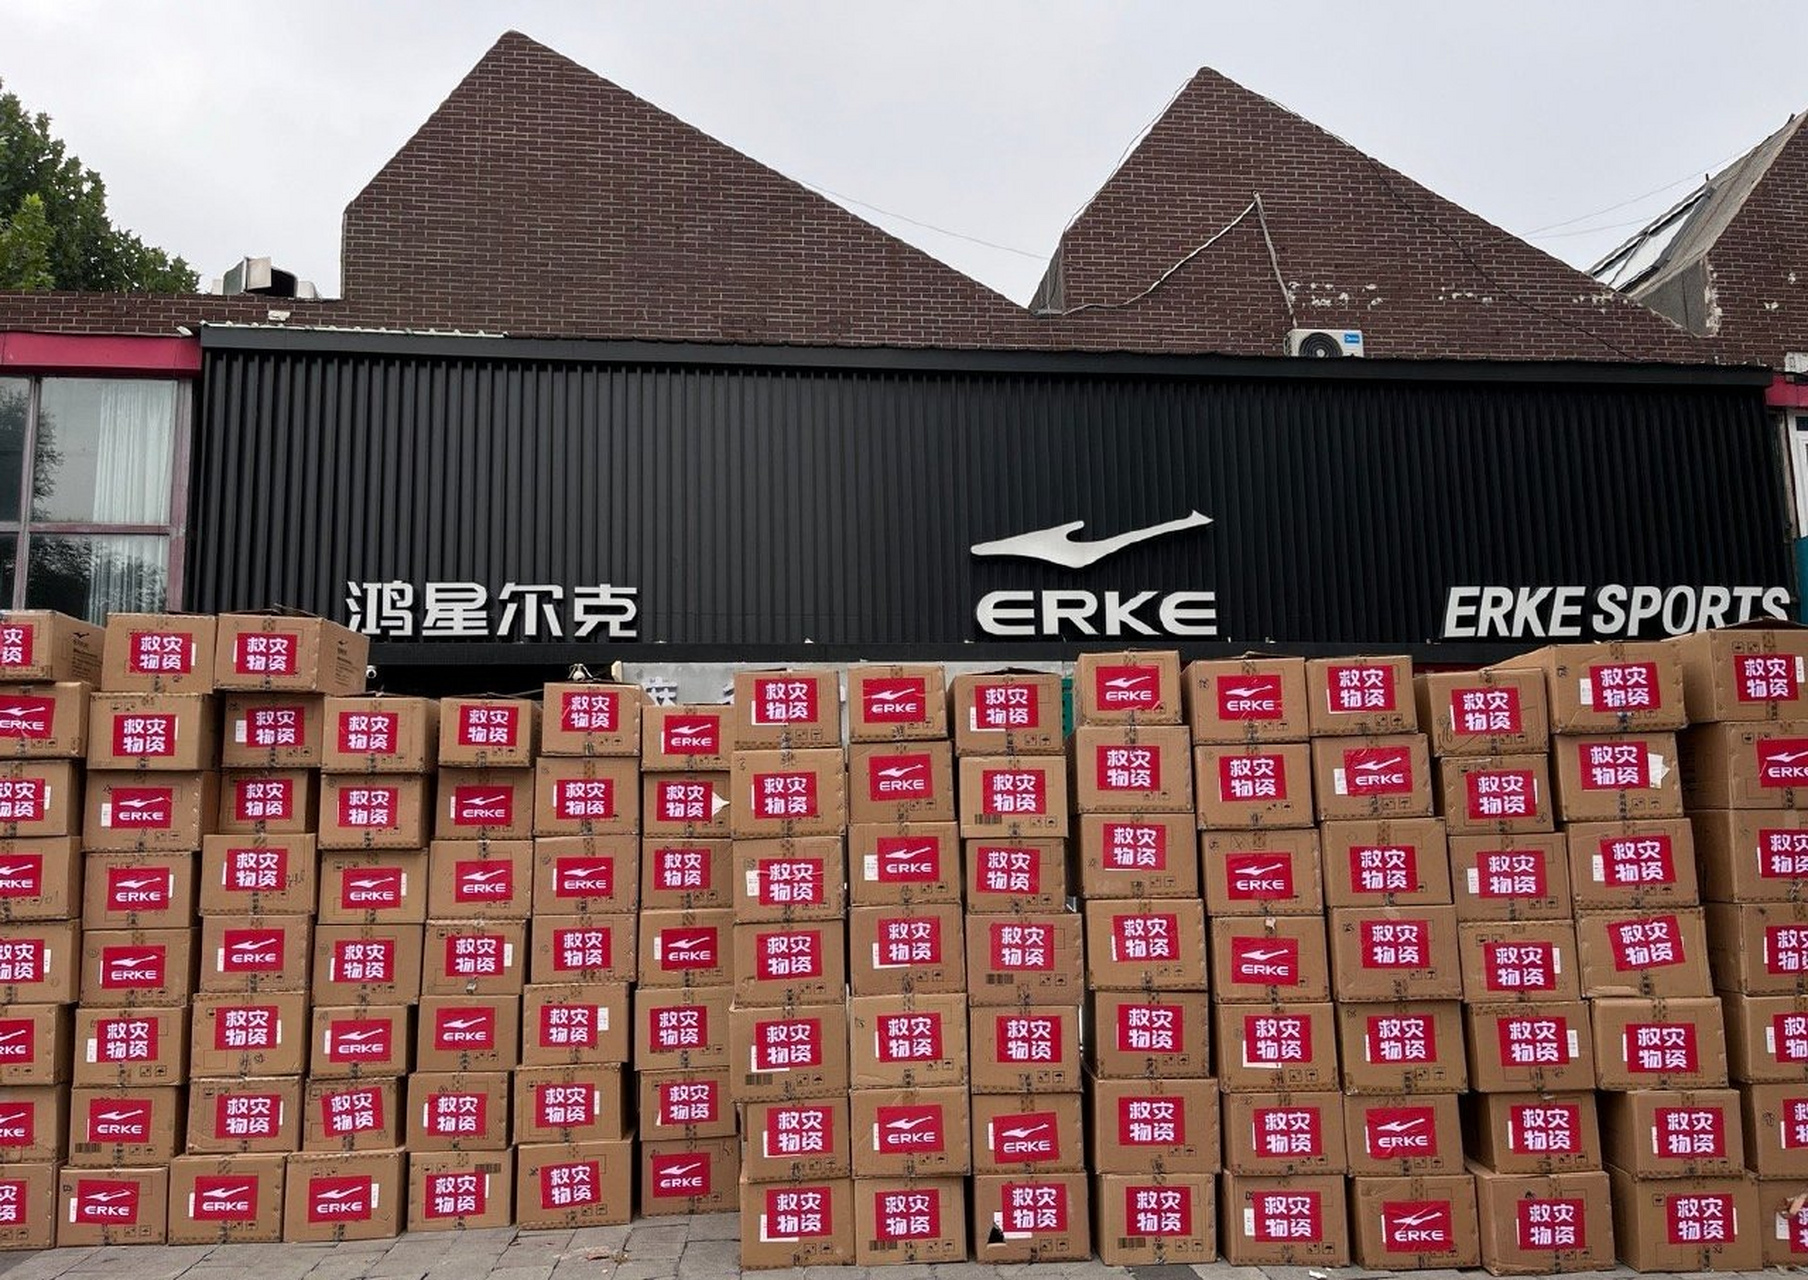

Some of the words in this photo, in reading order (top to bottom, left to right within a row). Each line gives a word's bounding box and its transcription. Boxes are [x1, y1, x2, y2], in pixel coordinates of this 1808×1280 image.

[345, 580, 637, 637] 鸿星尔克
[976, 590, 1217, 636] ERKE
[1444, 586, 1586, 638] ERKE
[1592, 584, 1790, 636] SPORTS
[140, 635, 183, 653] 救灾
[246, 636, 289, 654] 救灾
[139, 653, 182, 670] 物资
[246, 654, 288, 672] 物资
[1744, 657, 1787, 677] 救灾
[1338, 668, 1384, 688] 救灾
[985, 687, 1028, 706] 救灾
[1105, 690, 1152, 702] ERKE
[1746, 678, 1789, 698] 物资
[570, 695, 610, 712] 救灾
[871, 702, 917, 713] ERKE
[1226, 699, 1275, 712] ERKE
[1340, 688, 1385, 708] 物资
[1462, 690, 1509, 712] 救灾
[348, 715, 390, 733] 救灾
[469, 709, 509, 725] 救灾
[570, 711, 610, 729] 物资
[986, 707, 1029, 725] 物资
[1464, 711, 1511, 731] 物资
[123, 718, 167, 735] 救灾
[467, 725, 508, 743] 物资
[122, 735, 166, 753] 物资
[347, 733, 388, 754] 物资
[670, 737, 712, 747] ERKE
[1106, 749, 1151, 768] 救灾
[1590, 745, 1638, 765] 救灾
[763, 776, 807, 795] 救灾
[879, 779, 925, 791] ERKE
[993, 773, 1036, 792] 救灾
[1106, 768, 1151, 787] 物资
[1355, 773, 1404, 786] ERKE
[1477, 774, 1524, 794] 救灾
[1591, 766, 1639, 786] 物资
[246, 782, 284, 799] 救灾
[348, 790, 390, 806] 救灾
[565, 781, 606, 799] 救灾
[666, 784, 705, 801] 救灾
[245, 800, 283, 817] 物资
[565, 800, 605, 816] 物资
[666, 801, 704, 818] 物资
[764, 795, 808, 815] 物资
[992, 793, 1037, 812] 物资
[1479, 795, 1526, 815] 物资
[118, 811, 164, 821] ERKE
[348, 808, 389, 825] 物资
[462, 809, 505, 818] ERKE
[1113, 826, 1157, 847] 救灾
[1113, 846, 1157, 867] 物资
[1359, 848, 1406, 869] 救灾
[1612, 840, 1661, 861] 救灾
[236, 851, 279, 870] 救灾
[664, 852, 702, 870] 救灾
[885, 862, 932, 874] ERKE
[987, 850, 1031, 871] 救灾
[235, 869, 278, 888] 物资
[663, 869, 702, 887] 物资
[986, 870, 1030, 891] 物资
[1361, 869, 1407, 890] 物资
[1614, 861, 1664, 882] 物资
[462, 882, 506, 894] ERKE
[563, 879, 607, 890] ERKE
[1235, 879, 1285, 891] ERKE
[115, 891, 161, 902] ERKE
[349, 890, 394, 901] ERKE
[563, 931, 603, 949] 救灾
[888, 921, 931, 941] 救灾
[1000, 926, 1045, 946] 救灾
[1371, 924, 1418, 943] 救灾
[1619, 921, 1670, 945] 救灾
[455, 937, 497, 955] 救灾
[767, 935, 812, 955] 救灾
[888, 942, 932, 961] 物资
[1373, 945, 1419, 964] 物资
[1625, 941, 1673, 966] 物资
[231, 953, 276, 963] ERKE
[454, 956, 496, 973] 物资
[563, 948, 603, 967] 物资
[668, 950, 711, 961] ERKE
[767, 955, 812, 975] 物资
[1001, 947, 1045, 966] 物资
[1495, 946, 1543, 965] 救灾
[111, 970, 157, 981] ERKE
[1241, 963, 1289, 976] ERKE
[1497, 967, 1545, 986] 物资
[225, 1009, 269, 1028] 救灾
[549, 1007, 589, 1025] 救灾
[659, 1010, 699, 1028] 救灾
[1128, 1008, 1173, 1028] 救灾
[225, 1027, 268, 1046] 物资
[442, 1031, 487, 1041] ERKE
[549, 1026, 588, 1043] 物资
[659, 1027, 699, 1046] 物资
[766, 1023, 811, 1044] 救灾
[887, 1016, 932, 1038] 救灾
[1006, 1019, 1052, 1039] 救灾
[1255, 1018, 1301, 1039] 救灾
[1378, 1018, 1424, 1039] 救灾
[1508, 1020, 1556, 1041] 救灾
[1128, 1028, 1173, 1049] 物资
[1637, 1027, 1686, 1047] 救灾
[338, 1043, 384, 1054] ERKE
[766, 1044, 812, 1065] 物资
[888, 1038, 933, 1058] 物资
[1007, 1040, 1052, 1060] 物资
[1256, 1039, 1302, 1060] 物资
[1379, 1039, 1426, 1060] 物资
[1511, 1042, 1559, 1062] 物资
[1638, 1049, 1687, 1069] 物资
[545, 1086, 587, 1105] 救灾
[669, 1084, 710, 1103] 救灾
[437, 1095, 478, 1114] 救灾
[669, 1103, 710, 1120] 物资
[1129, 1101, 1175, 1120] 救灾
[436, 1115, 477, 1132] 物资
[544, 1105, 586, 1124] 物资
[777, 1110, 823, 1131] 救灾
[1264, 1111, 1311, 1131] 救灾
[1522, 1108, 1570, 1129] 救灾
[1666, 1111, 1714, 1131] 救灾
[96, 1124, 143, 1134] ERKE
[886, 1131, 936, 1144] ERKE
[1129, 1122, 1175, 1142] 物资
[777, 1131, 823, 1154] 物资
[1003, 1140, 1051, 1154] ERKE
[1266, 1133, 1312, 1154] 物资
[1377, 1135, 1428, 1149] ERKE
[1523, 1129, 1571, 1151] 物资
[1668, 1133, 1715, 1154] 物资
[435, 1174, 477, 1195] 救灾
[550, 1164, 591, 1186] 救灾
[551, 1184, 592, 1205] 物资
[776, 1191, 822, 1212] 救灾
[1012, 1186, 1057, 1208] 救灾
[84, 1205, 130, 1216] ERKE
[202, 1201, 249, 1212] ERKE
[316, 1201, 363, 1214] ERKE
[434, 1195, 476, 1214] 物资
[885, 1194, 930, 1215] 救灾
[1264, 1196, 1311, 1216] 救灾
[1676, 1197, 1723, 1219] 救灾
[776, 1213, 822, 1233] 物资
[885, 1215, 930, 1236] 物资
[1012, 1208, 1057, 1229] 物资
[1265, 1218, 1312, 1237] 物资
[1394, 1230, 1444, 1242] ERKE
[1678, 1219, 1724, 1241] 物资
